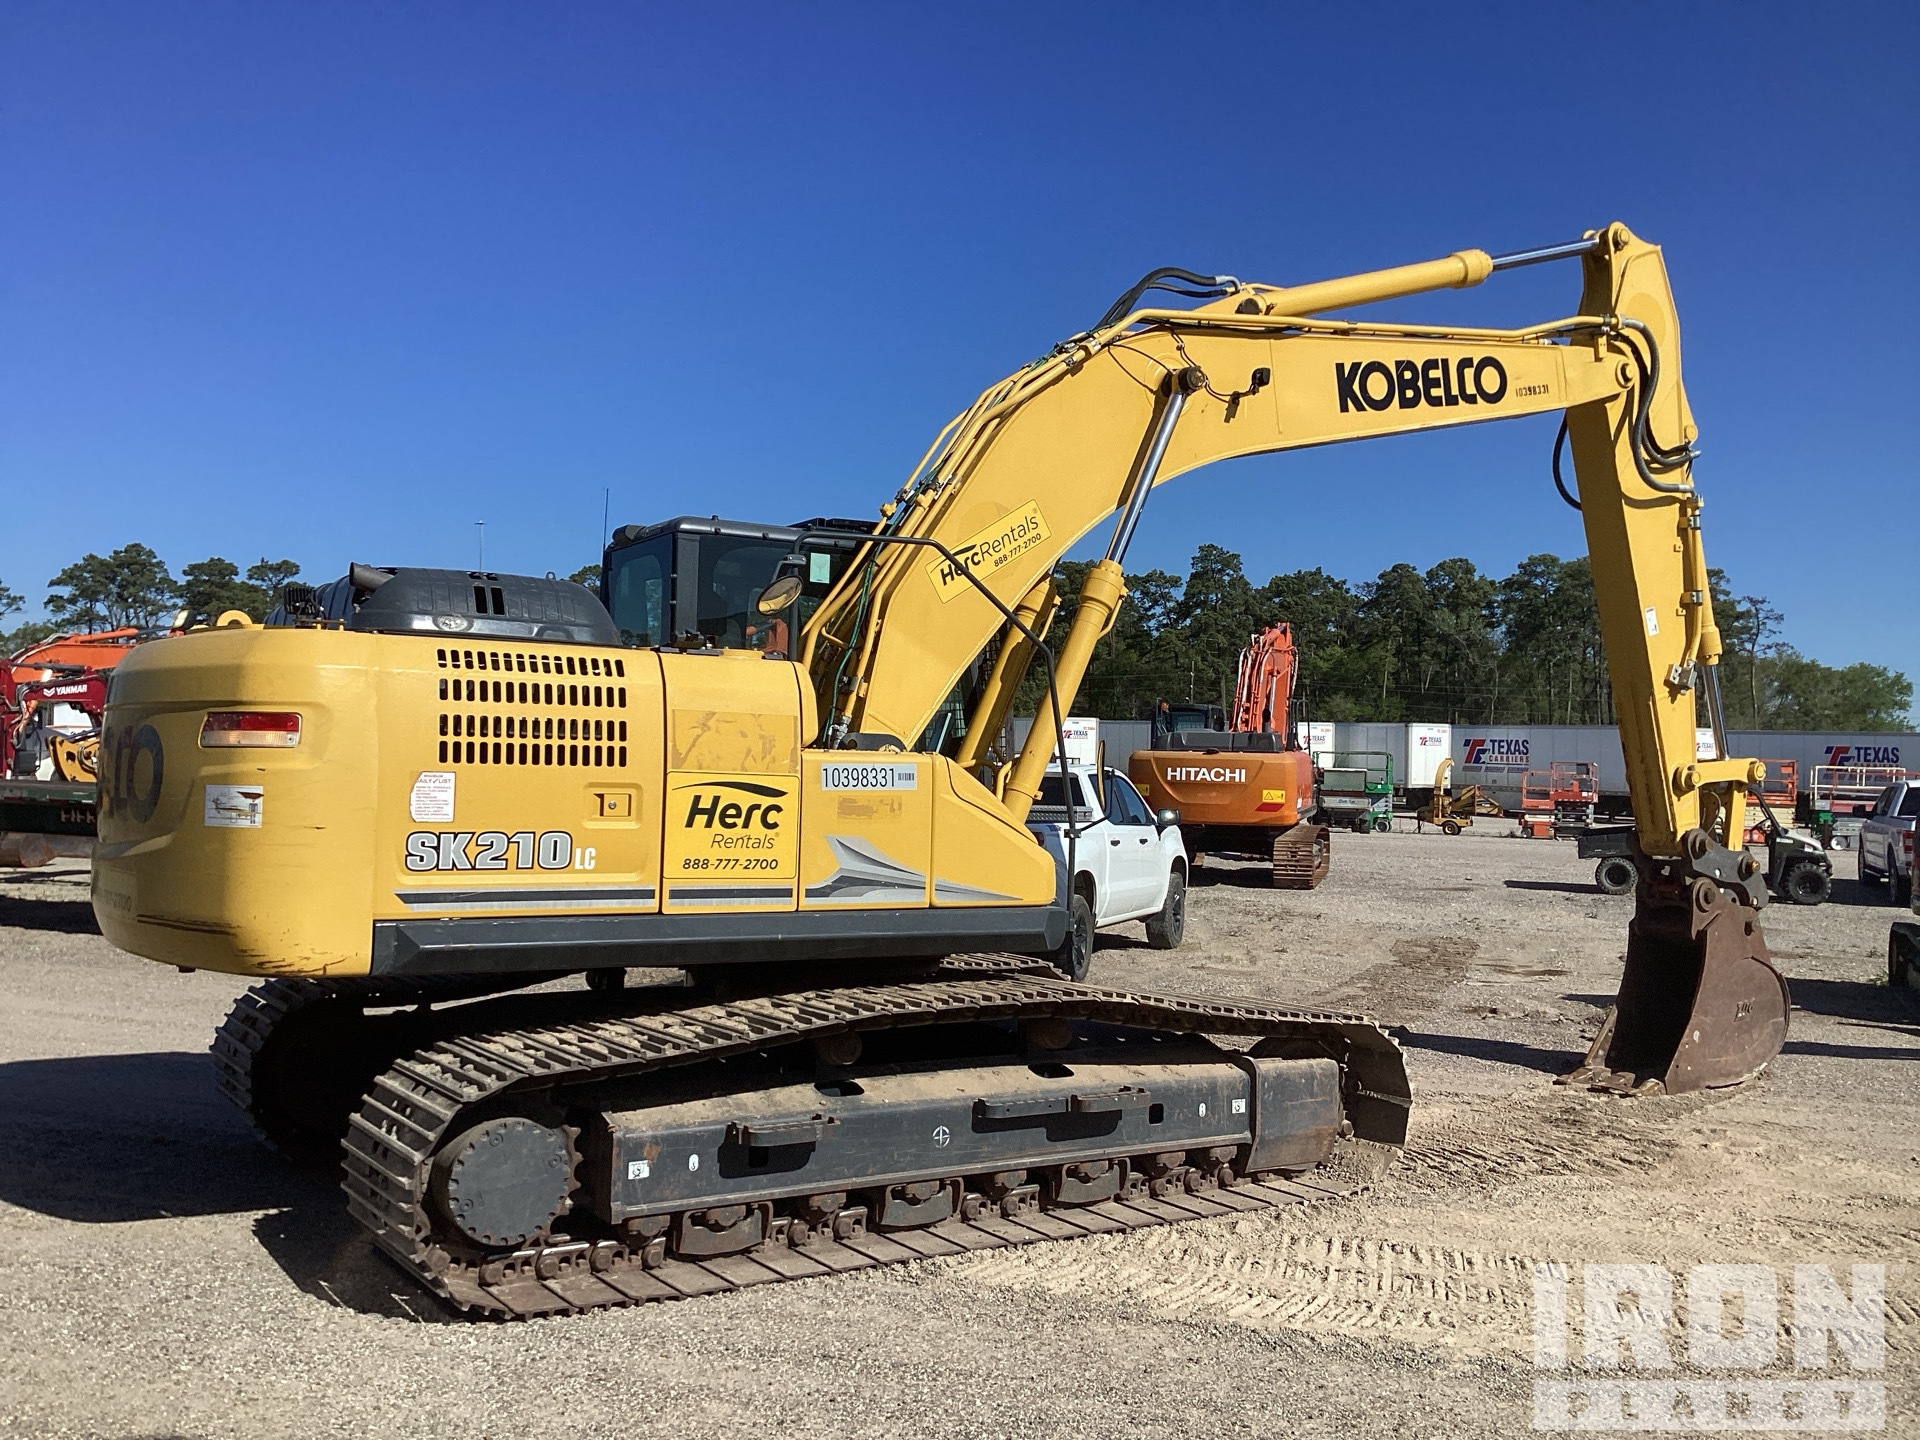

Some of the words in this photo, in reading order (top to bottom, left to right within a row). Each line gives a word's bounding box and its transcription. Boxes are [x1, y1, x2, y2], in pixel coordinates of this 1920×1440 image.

[1335, 356, 1508, 413] KOBELCO
[1515, 384, 1549, 398] 10398331
[993, 532, 1042, 568] 888-777-2700
[56, 684, 88, 696] YANMAR
[1489, 739, 1529, 756] TEXAS
[1855, 746, 1900, 764] TEXAS
[1488, 755, 1530, 763] CARRIERS
[822, 767, 895, 788] 10398331
[1166, 767, 1247, 783] HITACHI
[684, 794, 784, 830] Herc
[710, 832, 775, 850] Rentals
[405, 830, 573, 872] SK210
[574, 847, 596, 870] LC
[682, 858, 779, 871] 888-777-2700
